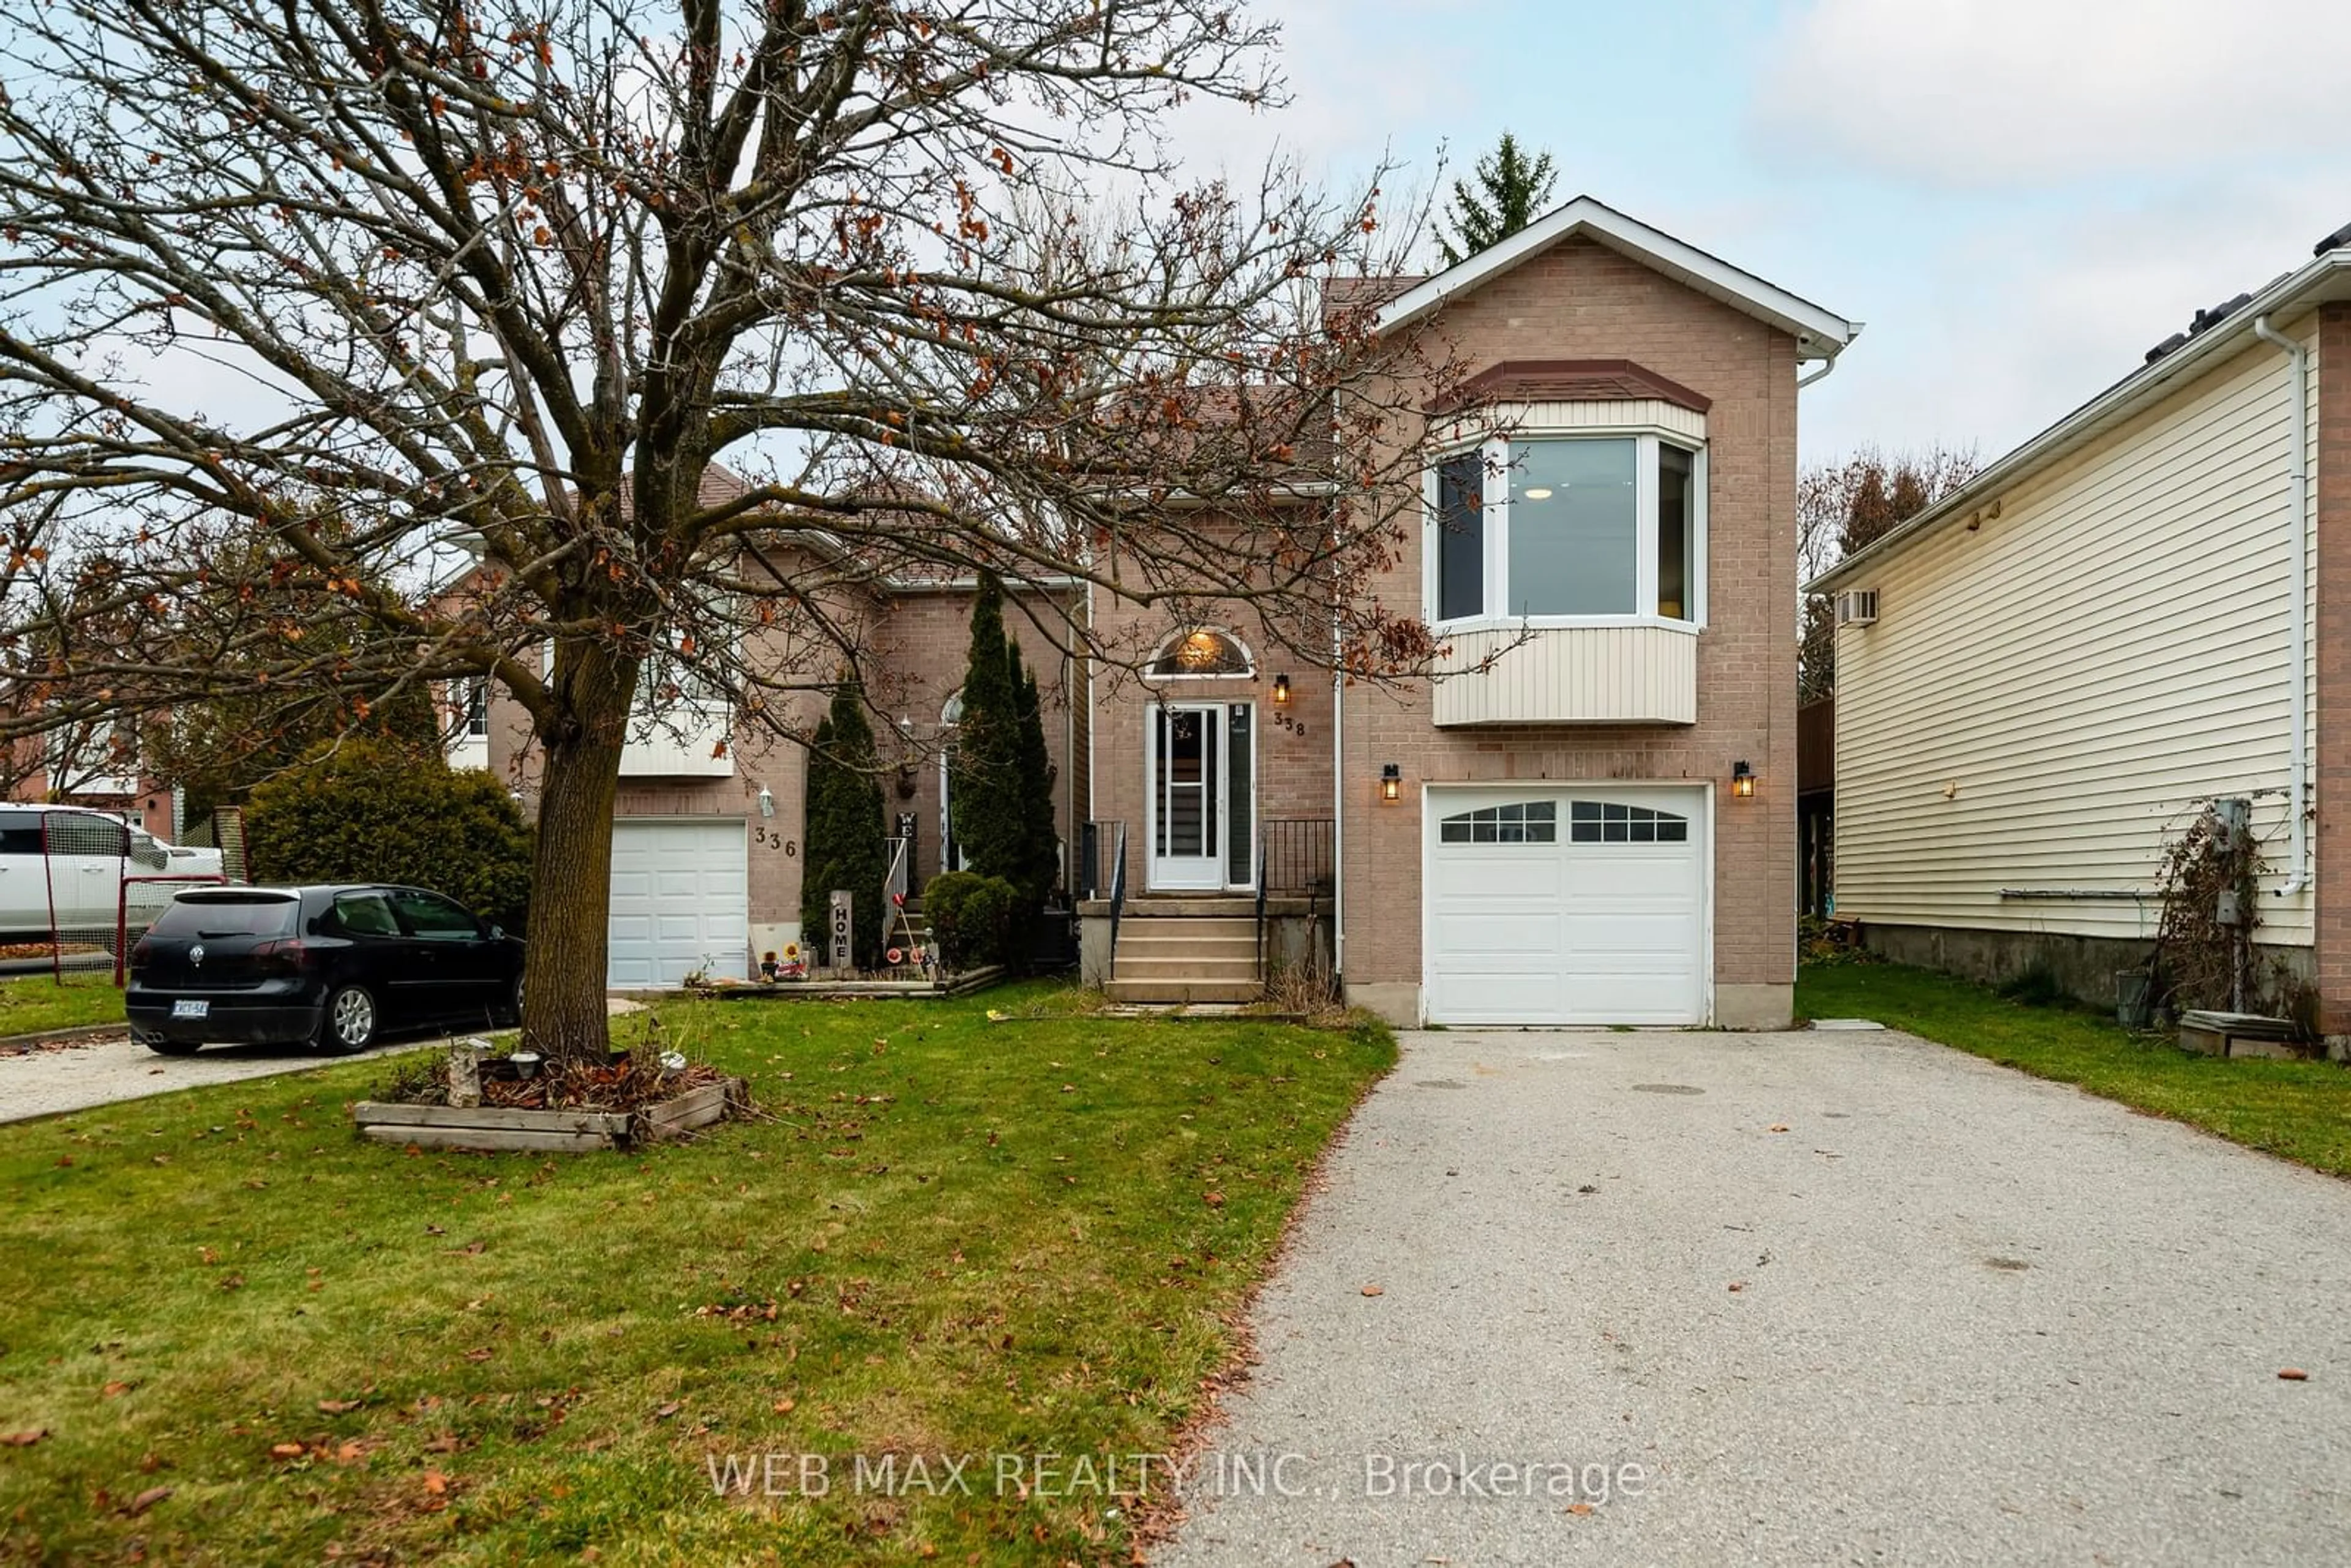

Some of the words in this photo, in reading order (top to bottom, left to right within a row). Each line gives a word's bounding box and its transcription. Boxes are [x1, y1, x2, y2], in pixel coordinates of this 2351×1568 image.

[1274, 712, 1305, 736] 338
[756, 827, 796, 857] 336
[835, 909, 847, 958] HOME
